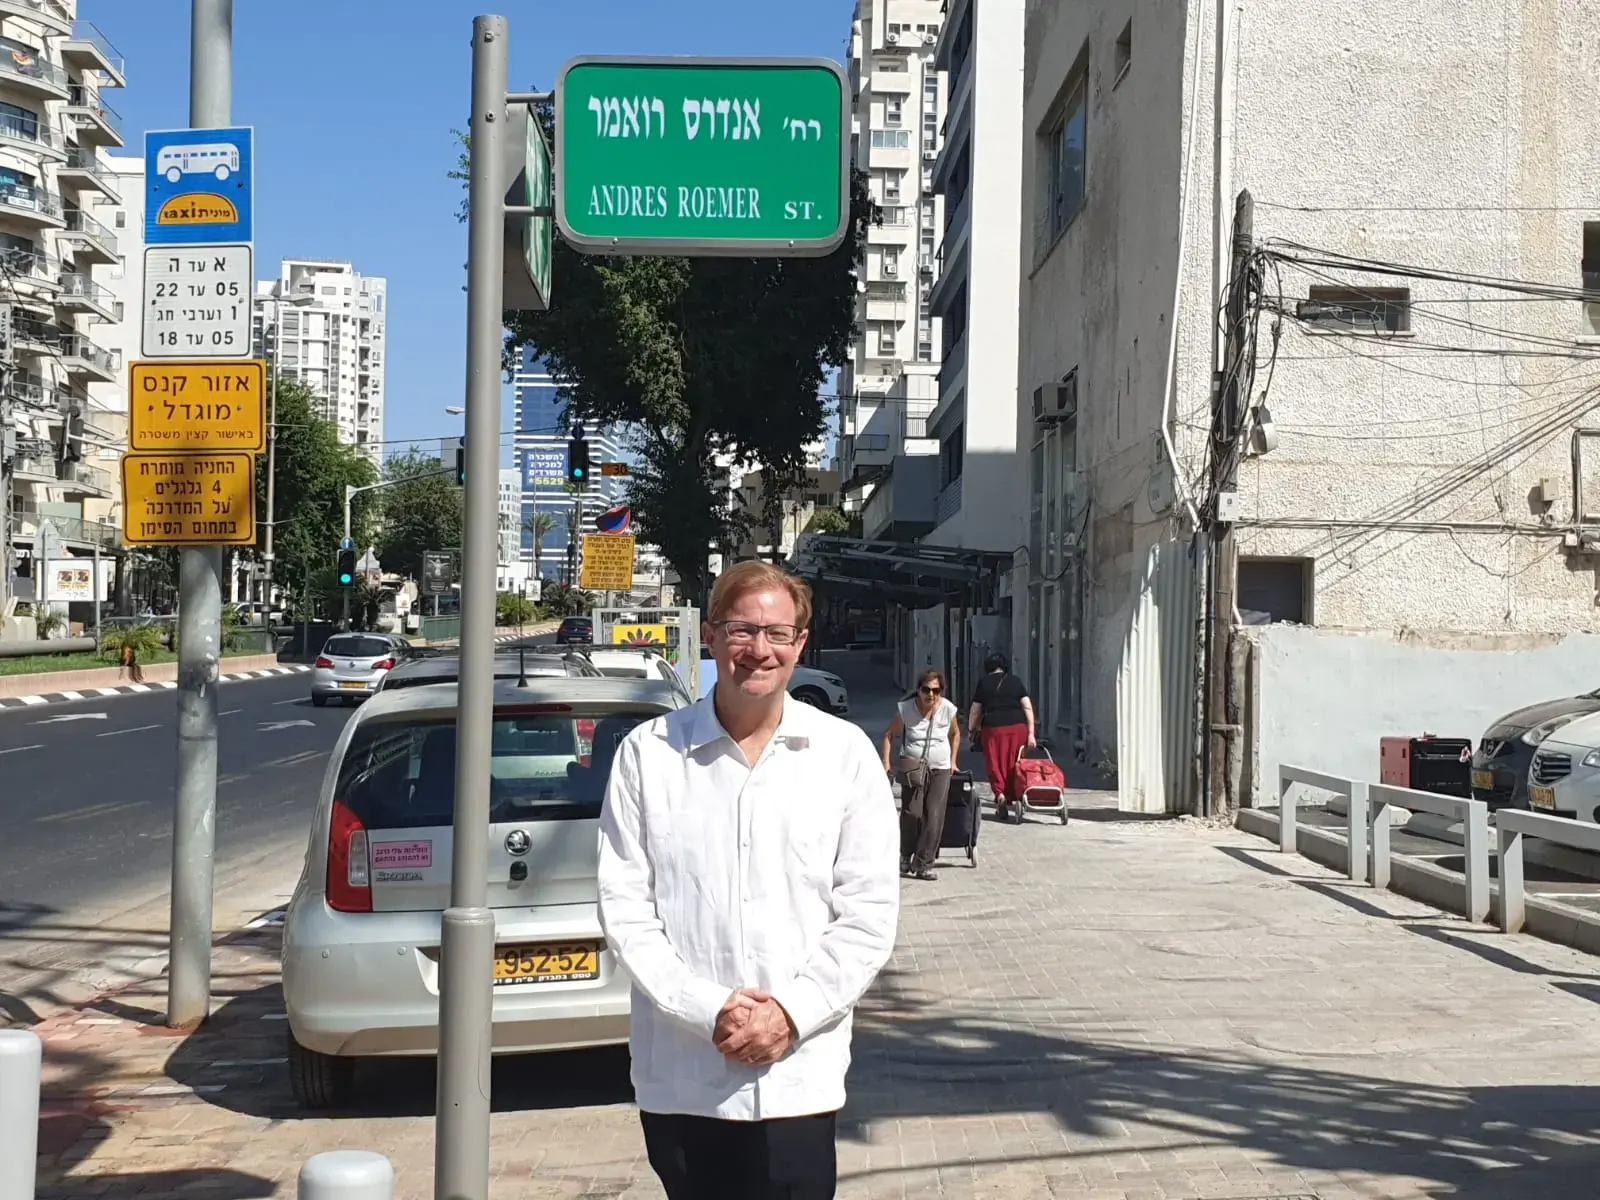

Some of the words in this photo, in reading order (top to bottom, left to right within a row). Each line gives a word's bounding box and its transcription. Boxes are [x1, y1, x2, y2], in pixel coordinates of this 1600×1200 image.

[588, 95, 665, 140] רואמר
[682, 97, 761, 140] אנדרס
[164, 201, 196, 218] taxi
[588, 185, 667, 217] ANDRES
[678, 187, 761, 219] ROEMER
[784, 201, 822, 220] ST.
[198, 208, 231, 218] מונית
[168, 258, 180, 272] ה
[188, 261, 206, 272] עד
[214, 257, 226, 271] א
[156, 282, 178, 297] 22
[187, 285, 206, 297] עד
[216, 282, 239, 296] 05
[157, 309, 174, 321] חג
[182, 309, 221, 321] וערבי
[158, 331, 178, 346] 18
[185, 334, 204, 346] עד
[212, 331, 234, 345] 05
[143, 376, 188, 396] קנס
[201, 376, 250, 391] אזור
[163, 400, 232, 420] מוגדל
[139, 430, 181, 440] משטרה
[186, 430, 209, 441] קצין
[216, 430, 254, 440] באישור
[140, 462, 184, 476] מותרת
[193, 461, 235, 475] החניה
[155, 480, 202, 495] גלגלים
[212, 480, 221, 494] 4
[146, 502, 202, 515] המדרכה
[212, 499, 232, 514] על
[140, 521, 182, 537] הסימן
[192, 521, 237, 534] בתחום
